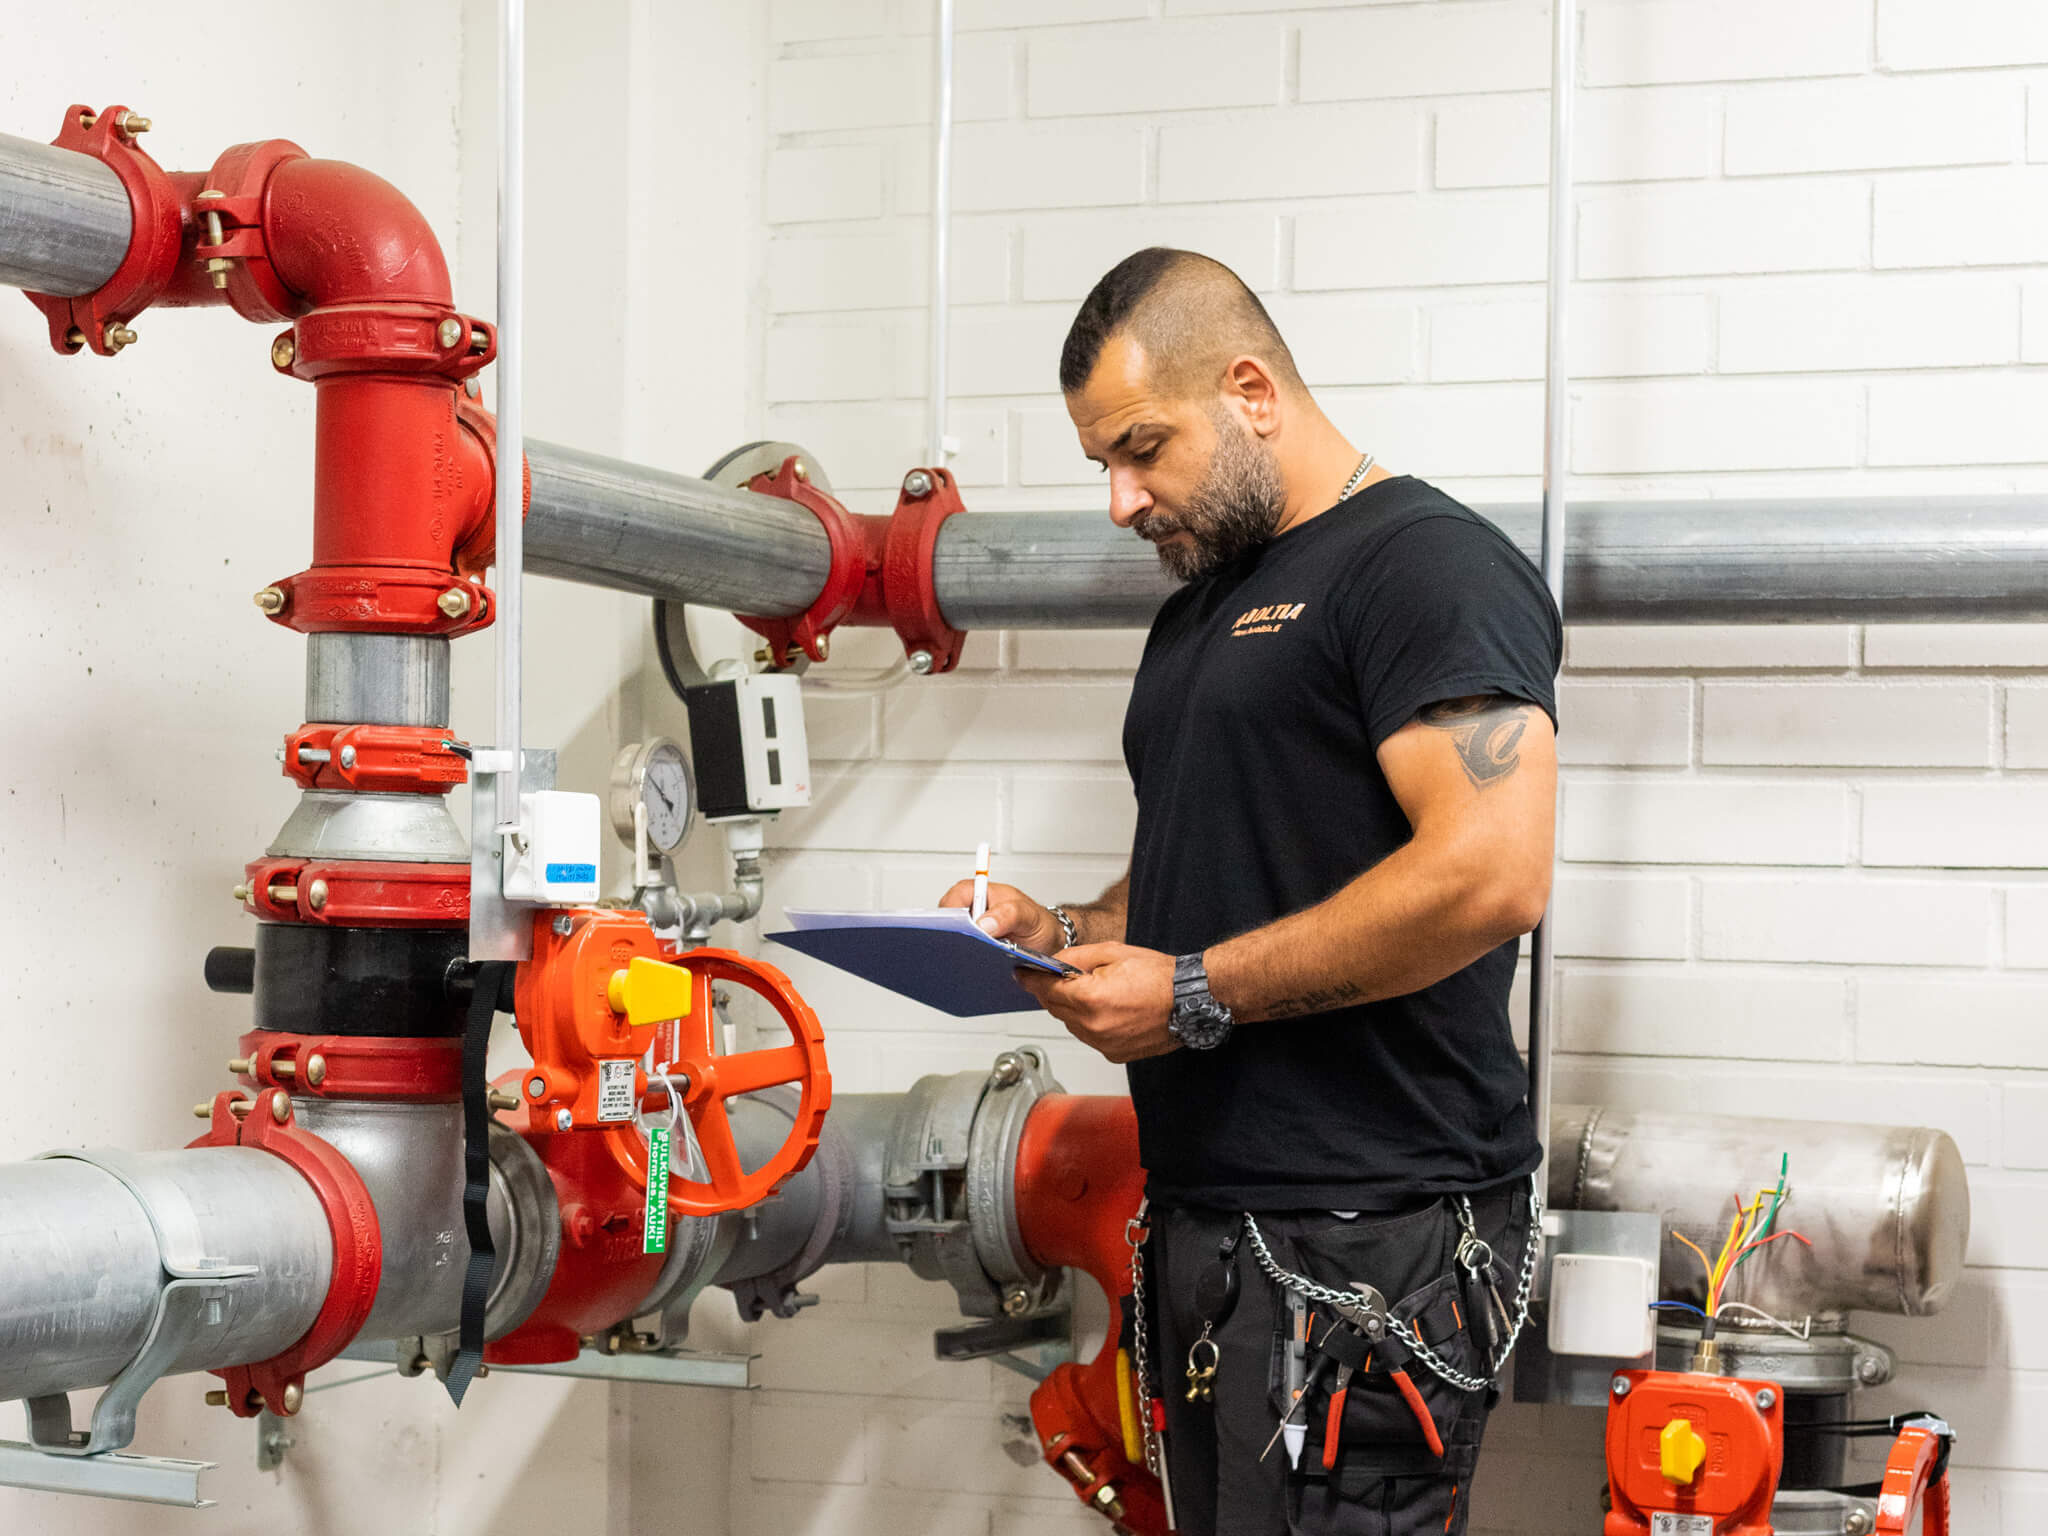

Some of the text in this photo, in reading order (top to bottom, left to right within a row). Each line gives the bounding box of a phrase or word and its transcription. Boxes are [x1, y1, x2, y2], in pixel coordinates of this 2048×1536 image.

[648, 1142, 659, 1240] norm.as. AUKI
[655, 1131, 669, 1248] SULKUVENTTIILI
